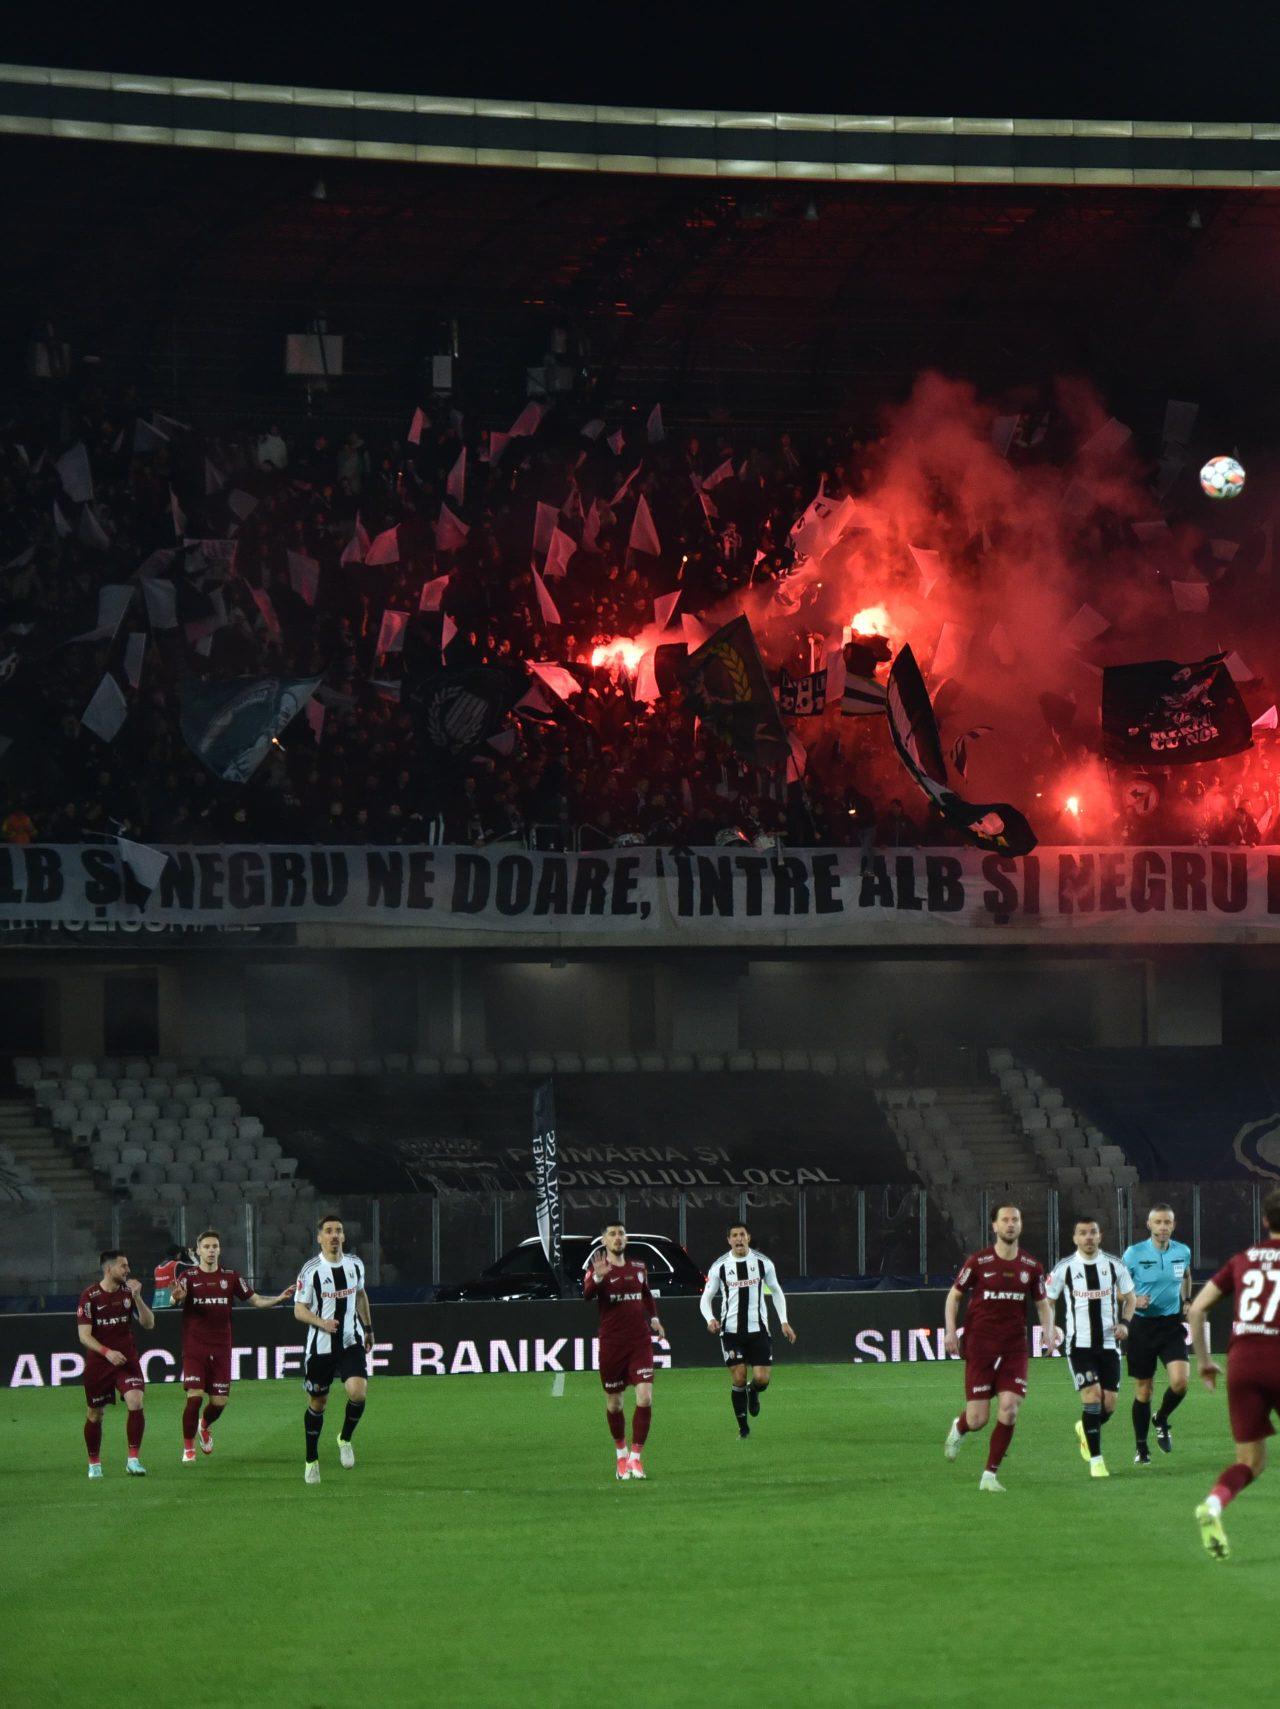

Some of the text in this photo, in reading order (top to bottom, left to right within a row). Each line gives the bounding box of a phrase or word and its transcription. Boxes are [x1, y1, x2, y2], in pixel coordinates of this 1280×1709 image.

[160, 852, 348, 909] NEGRU
[366, 851, 435, 908] NE
[451, 854, 651, 921] DOARE,
[668, 847, 843, 916] ÎNTRE
[859, 854, 966, 912] ALB
[982, 854, 1040, 924] ȘI
[1058, 851, 1248, 914] NEGRU
[507, 1144, 690, 1162] PIMĂRIA
[723, 1167, 841, 1186] LOCAL
[192, 1297, 229, 1305] PLAYER
